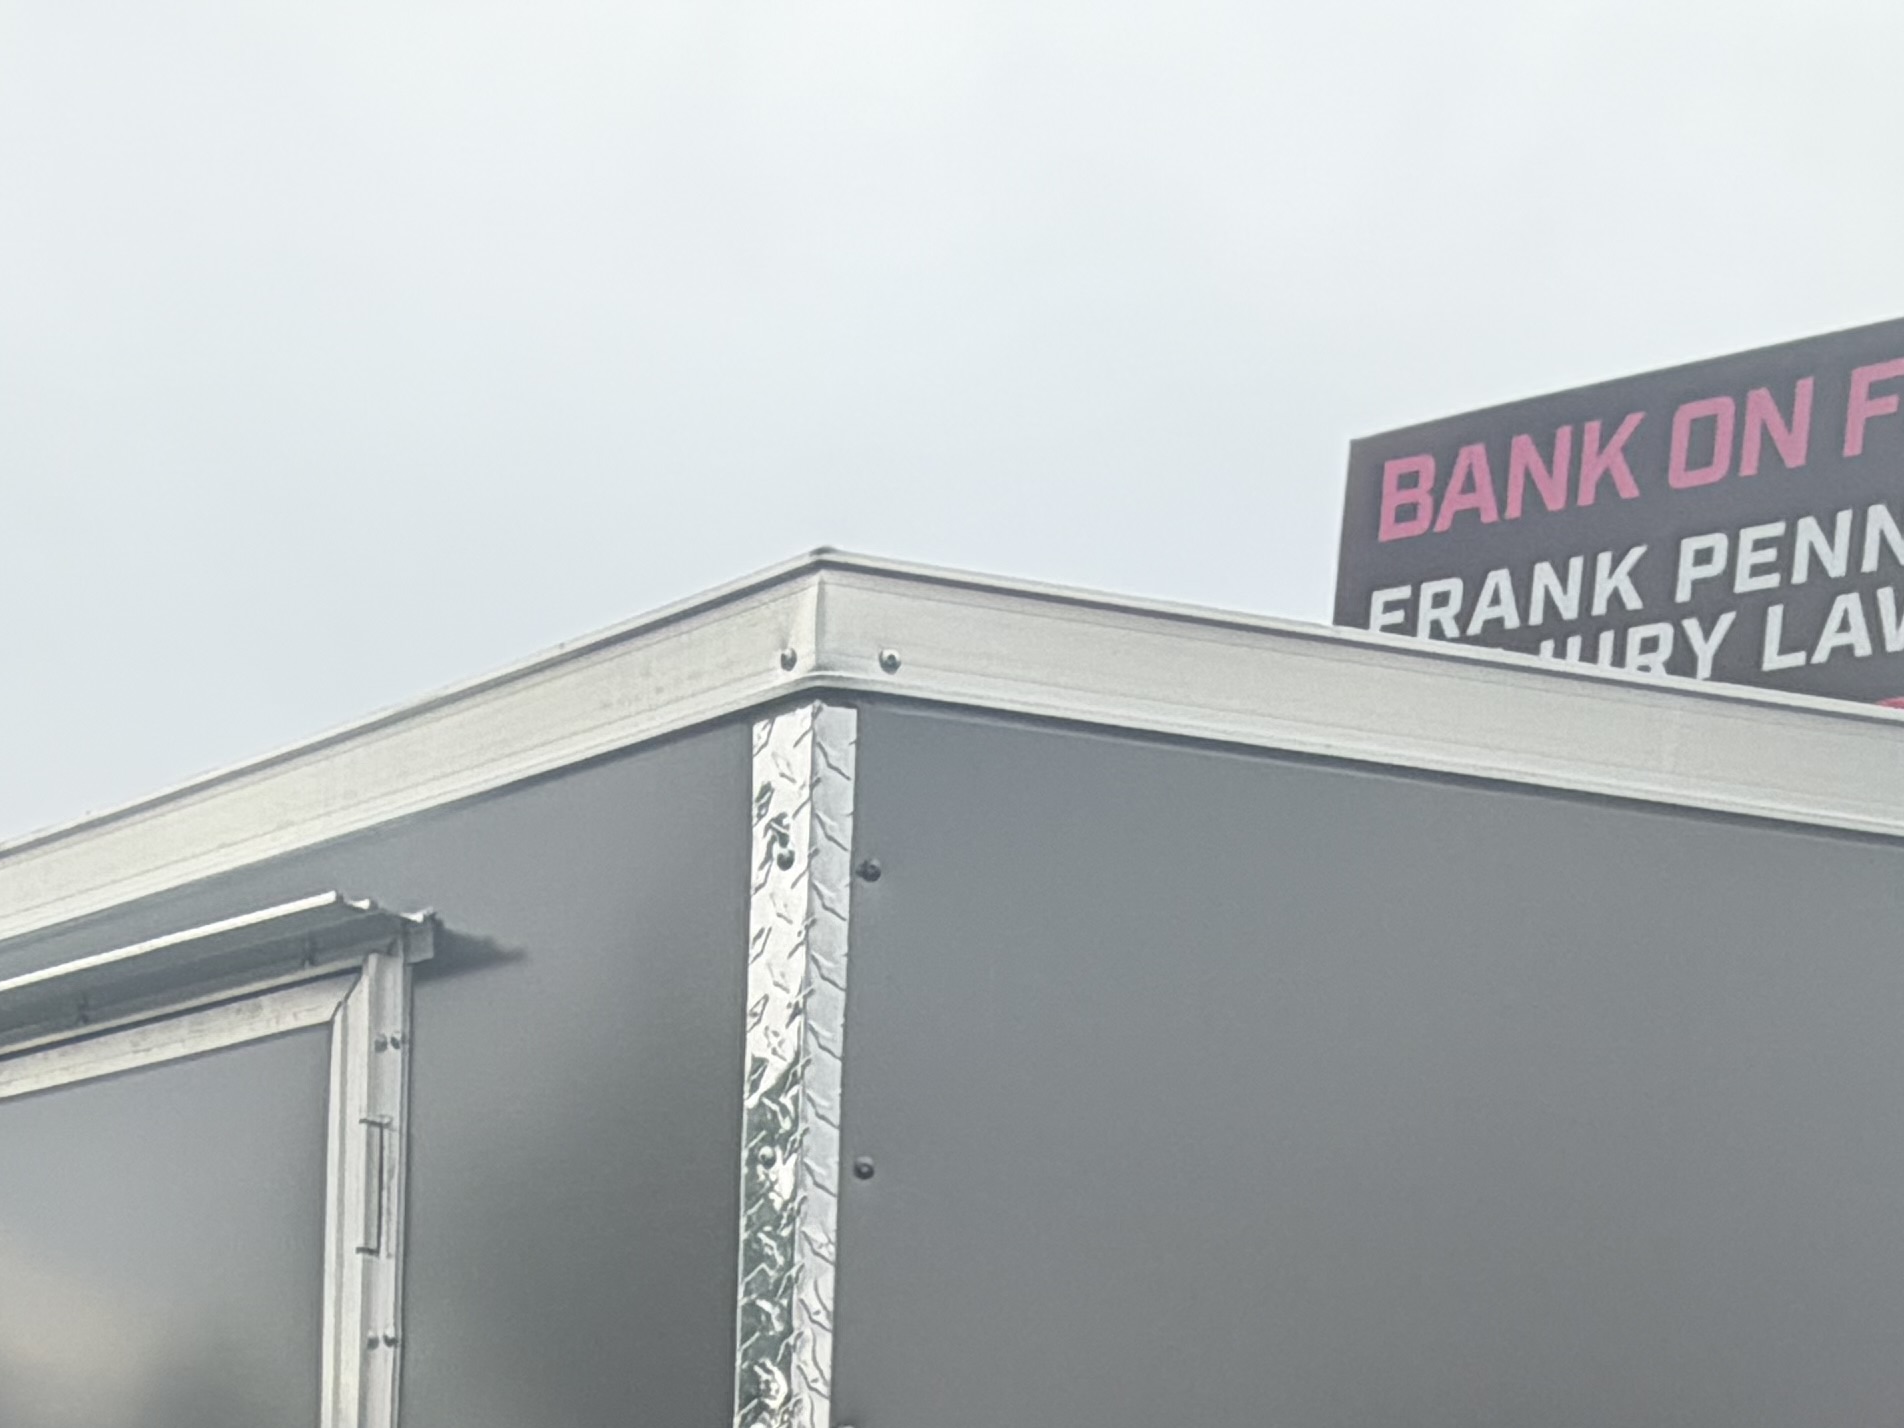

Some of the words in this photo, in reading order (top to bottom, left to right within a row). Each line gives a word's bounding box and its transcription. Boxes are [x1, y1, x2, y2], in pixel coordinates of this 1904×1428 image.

[1378, 411, 1647, 543] BANK
[1668, 376, 1815, 490] ON
[1368, 545, 1648, 639] FRANK
